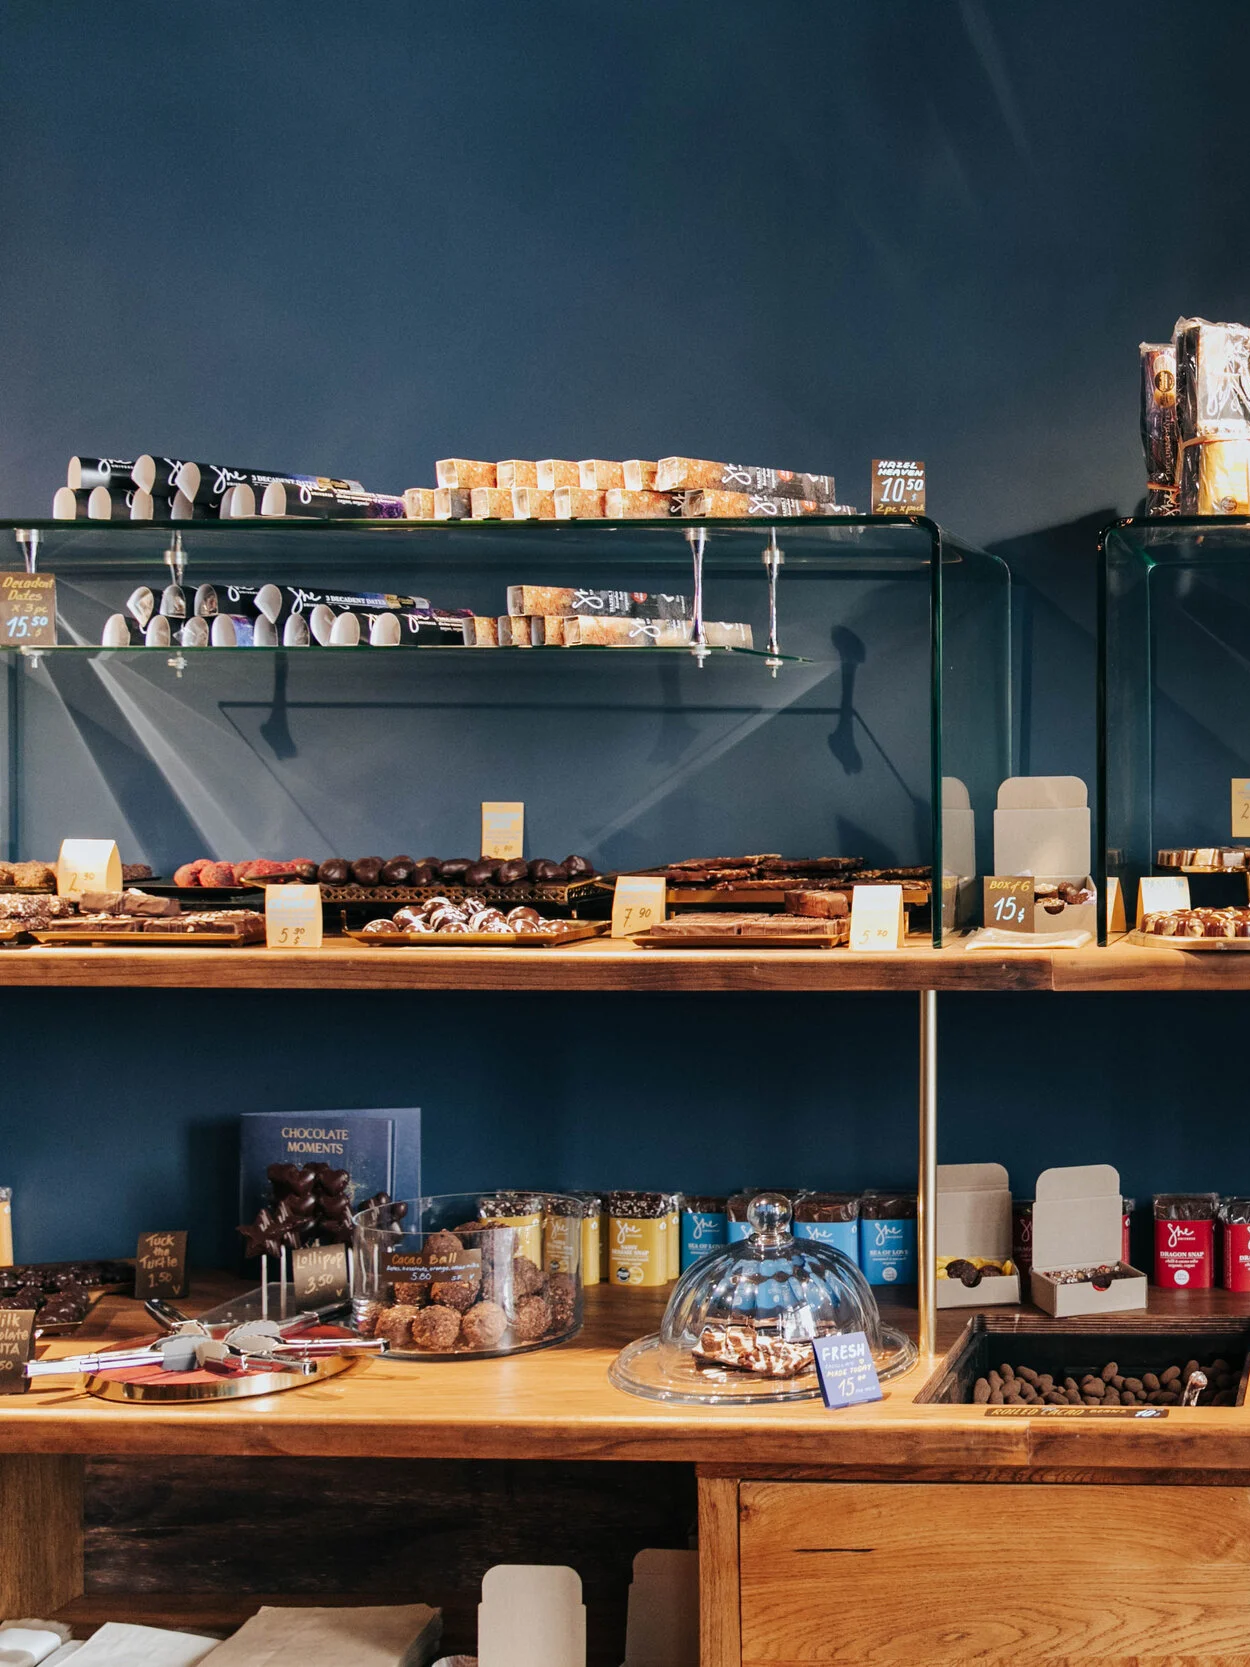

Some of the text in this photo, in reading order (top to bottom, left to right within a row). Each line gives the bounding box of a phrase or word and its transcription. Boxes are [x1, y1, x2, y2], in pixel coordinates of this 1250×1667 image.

[878, 461, 918, 469] HAZEL
[209, 464, 248, 494] She
[877, 469, 924, 477] HEAVEN
[2, 576, 55, 588] Decadent
[8, 589, 43, 601] Dates
[287, 586, 322, 614] She
[331, 595, 366, 604] DECADENT
[989, 880, 1011, 889] BOX
[1021, 881, 1031, 891] 6
[281, 1127, 349, 1140] CHOCOLATE
[287, 1141, 344, 1154] MOMENTS
[616, 1220, 641, 1243] She
[692, 1215, 719, 1239] She
[806, 1225, 833, 1241] She
[874, 1222, 902, 1246] She
[145, 1233, 175, 1246] Tuck
[1168, 1223, 1194, 1247] She
[139, 1254, 178, 1269] Turtle
[296, 1252, 345, 1270] Lollipop
[392, 1252, 457, 1265] Cacao Ball
[304, 1273, 334, 1295] 3.50
[822, 1343, 866, 1361] FRESH
[826, 1367, 847, 1377] MADE
[838, 1376, 855, 1397] 15
[991, 1408, 1040, 1416] ROLLED
